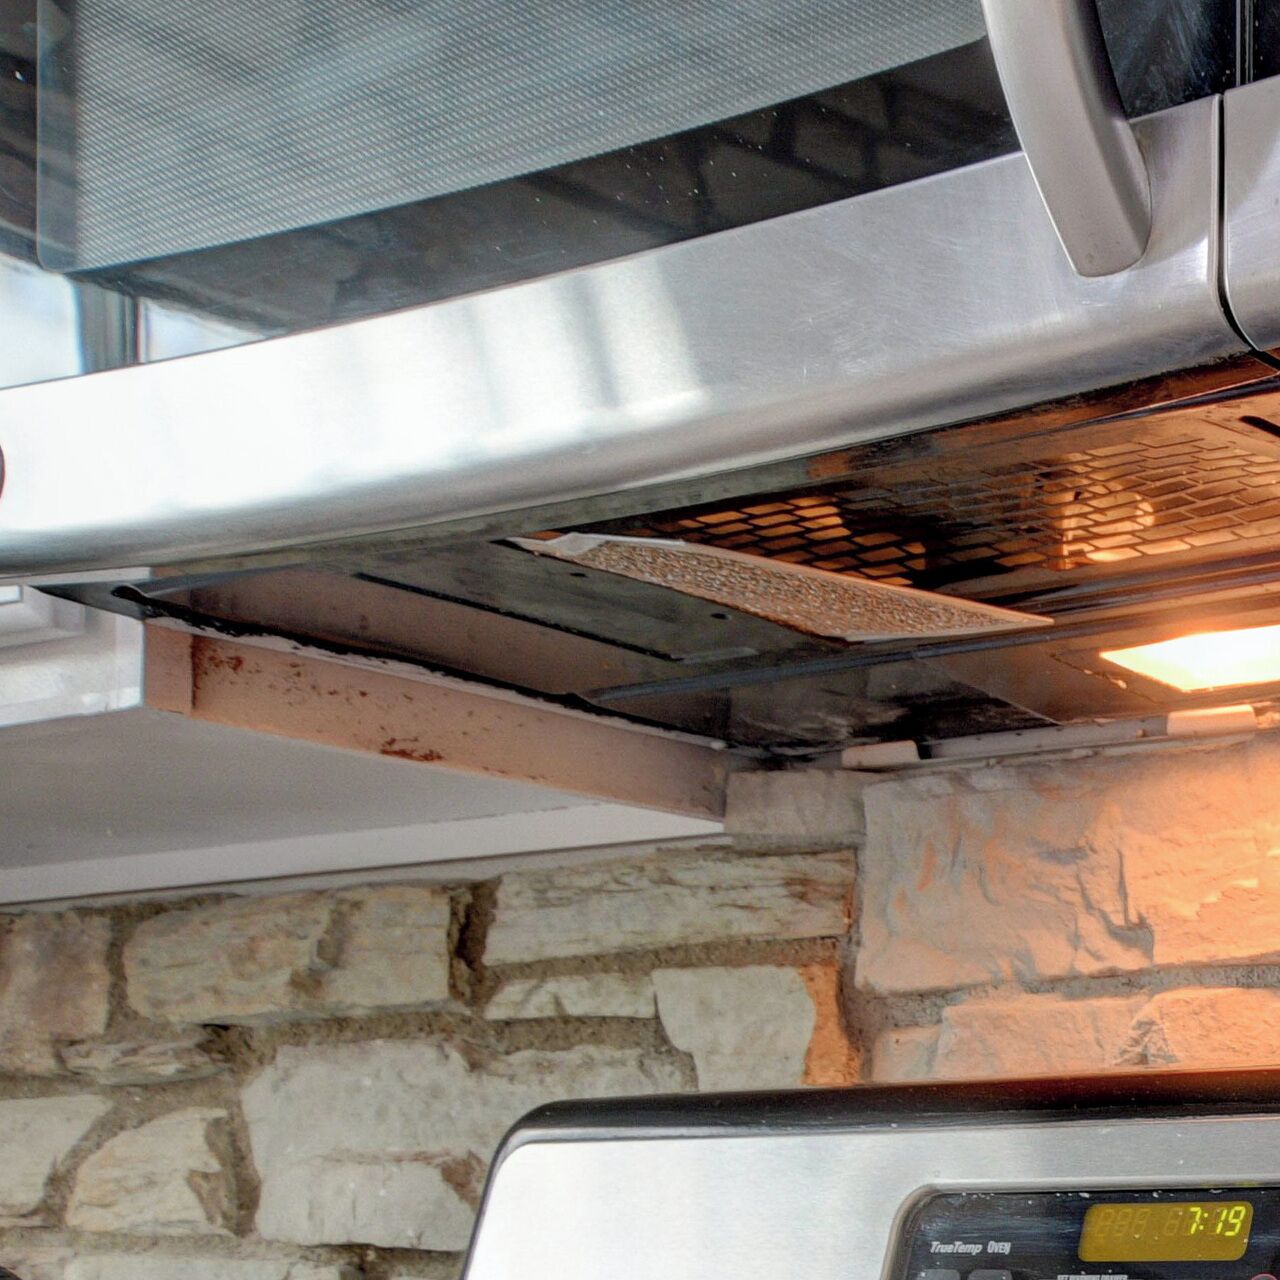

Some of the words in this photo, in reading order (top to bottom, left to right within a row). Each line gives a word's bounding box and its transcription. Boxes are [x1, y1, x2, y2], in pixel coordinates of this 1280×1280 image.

[1190, 1206, 1246, 1237] 7:19
[930, 1241, 983, 1256] TrueTemp
[987, 1240, 1012, 1254] OVEN
